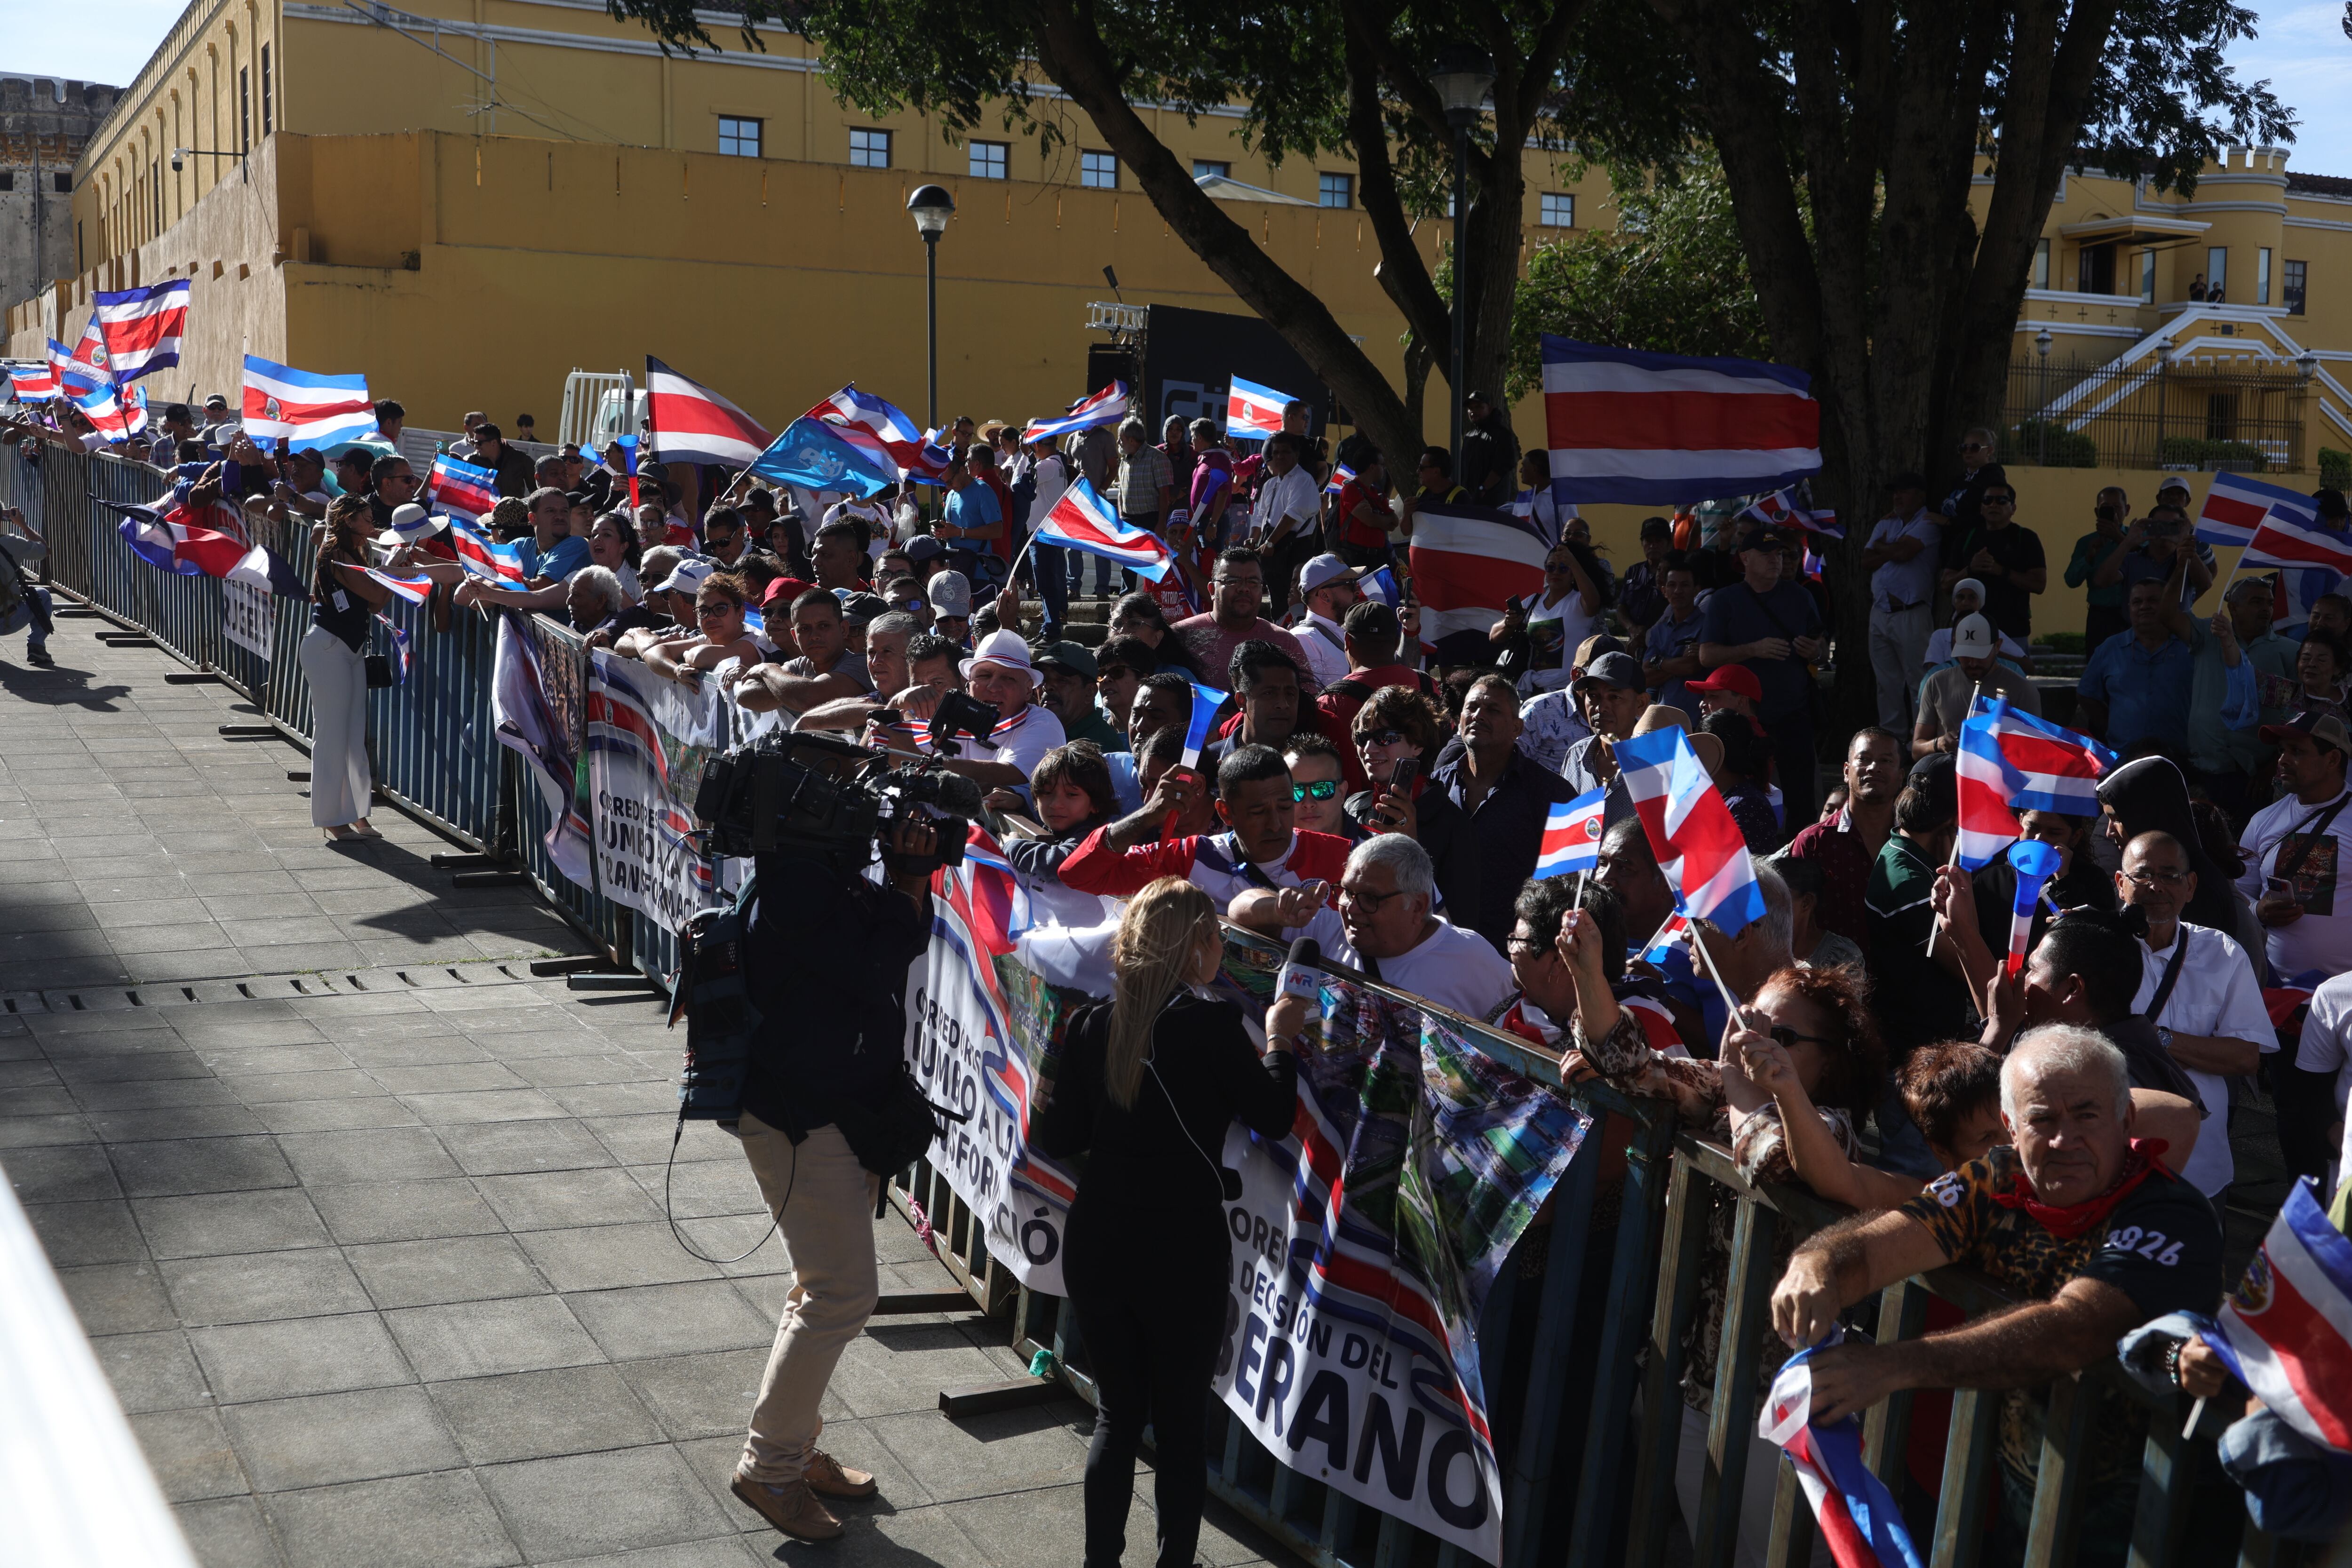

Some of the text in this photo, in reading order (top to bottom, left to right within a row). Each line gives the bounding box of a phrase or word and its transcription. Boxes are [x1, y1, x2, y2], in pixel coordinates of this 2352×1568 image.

[599, 790, 659, 831] CORREDORES
[1289, 972, 1313, 988] NR
[1240, 1260, 1333, 1359] DECISIÓN
[1340, 1332, 1399, 1390] DEL
